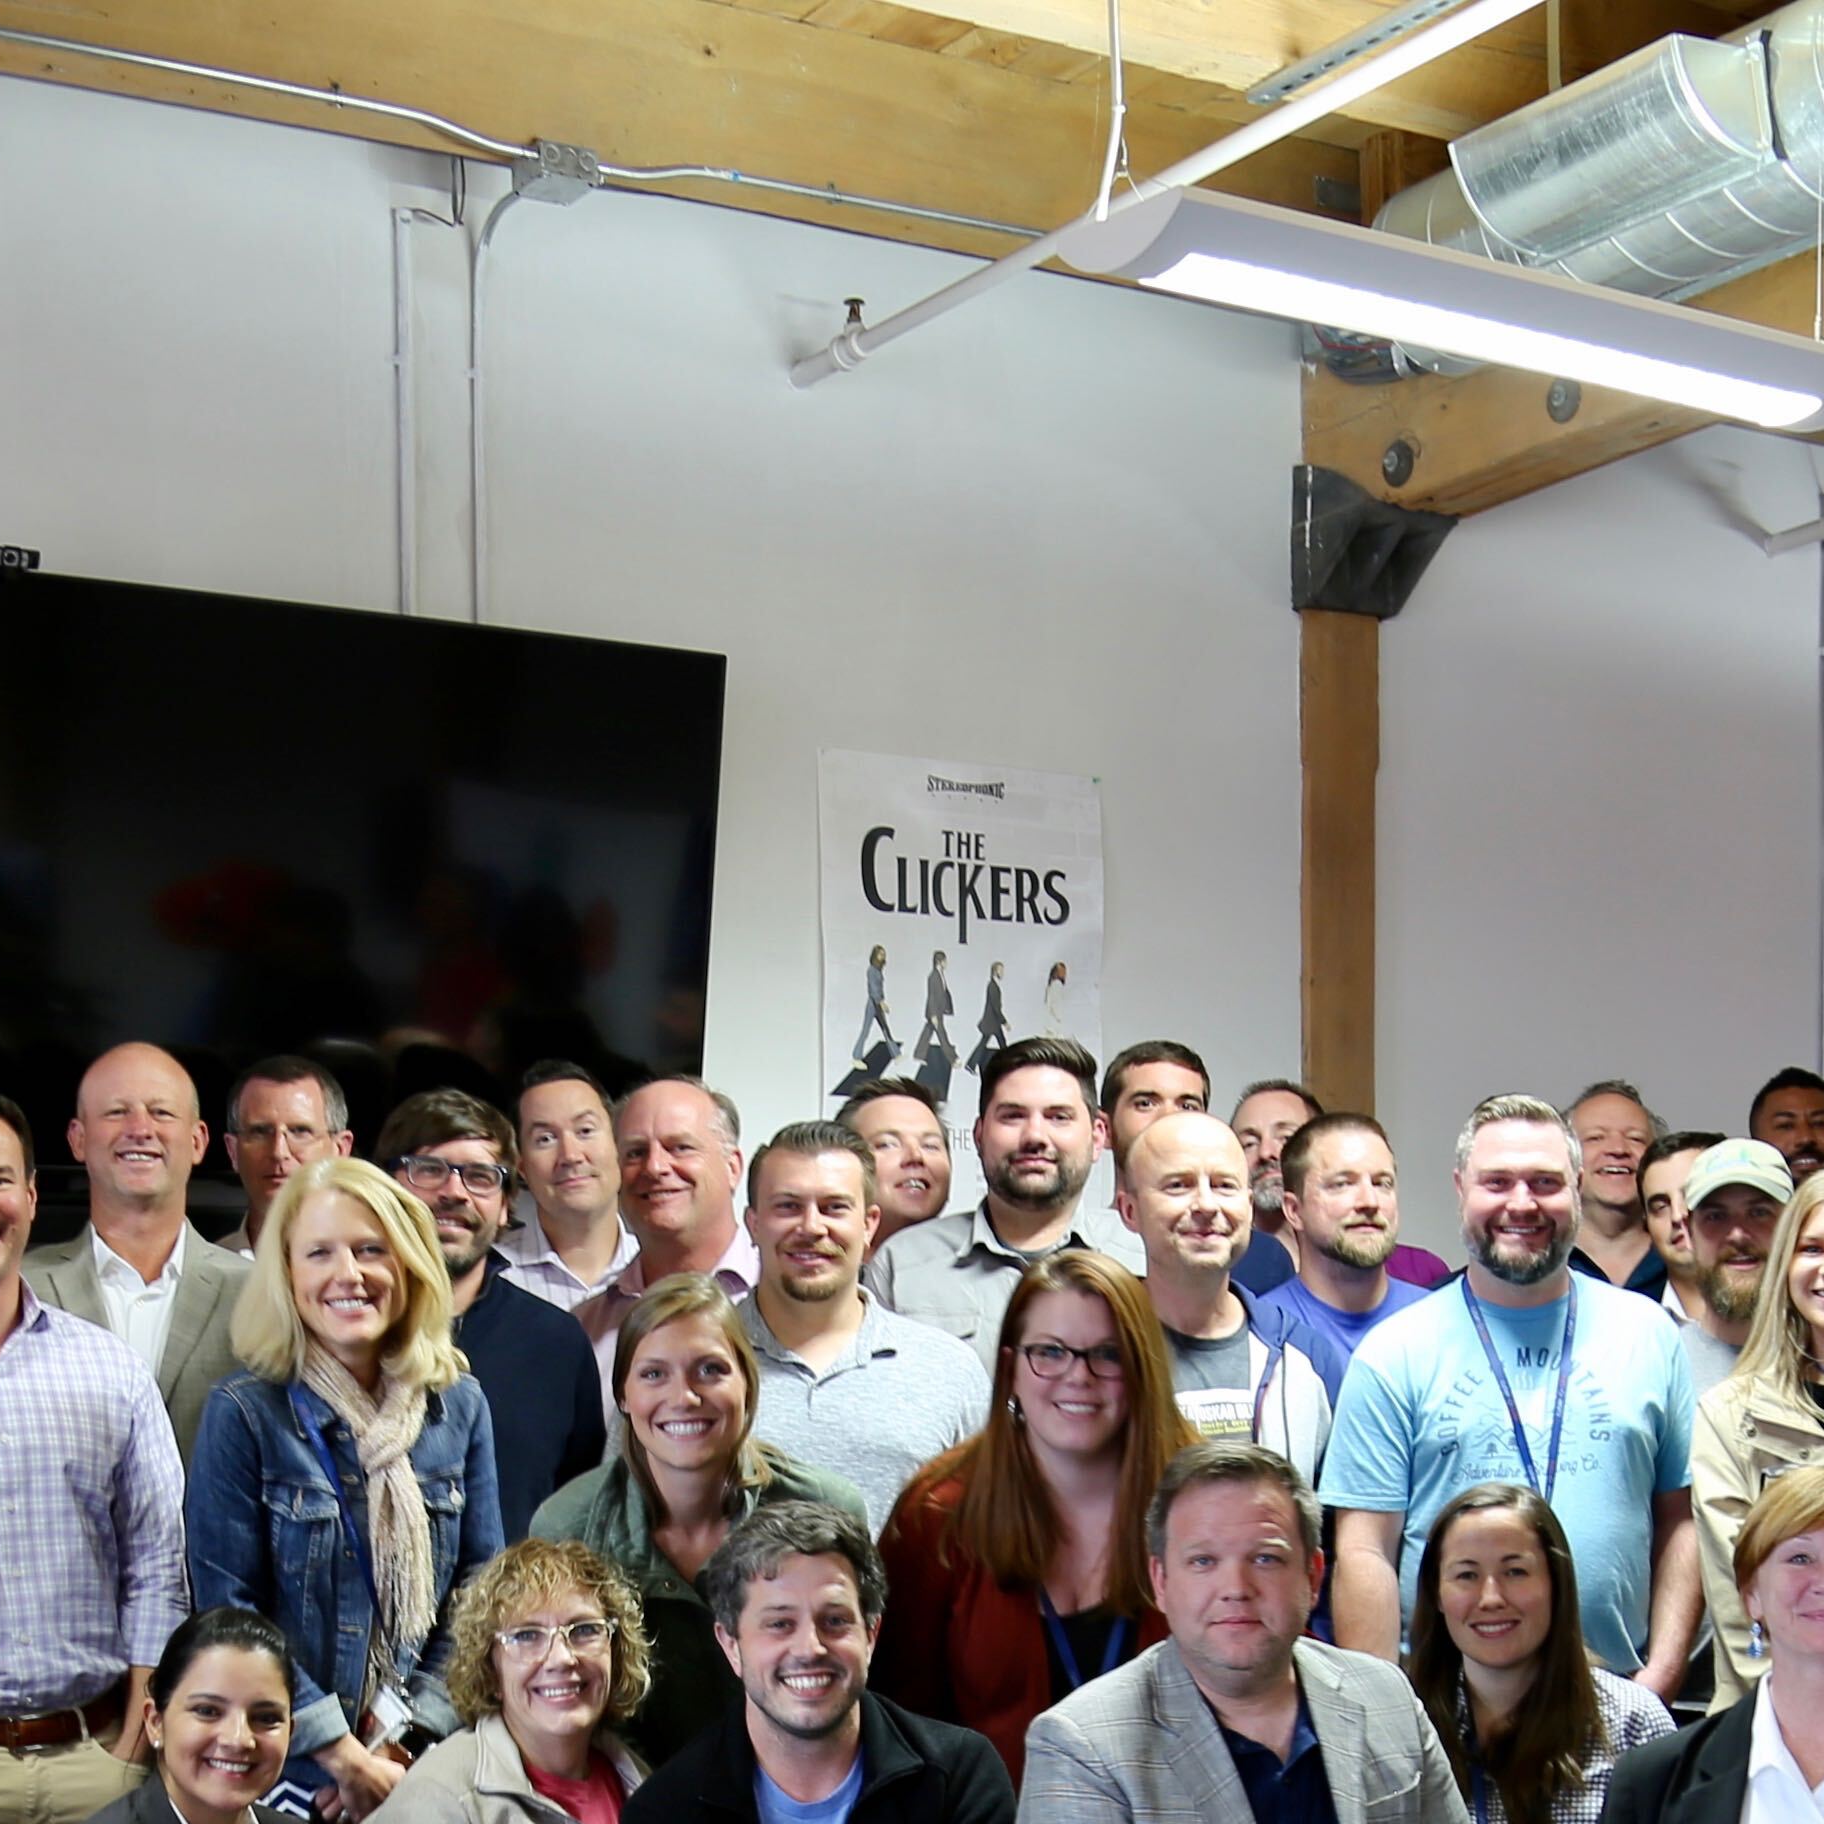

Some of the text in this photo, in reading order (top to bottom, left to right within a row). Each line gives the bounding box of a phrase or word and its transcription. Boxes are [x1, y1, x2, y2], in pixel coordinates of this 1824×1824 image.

[927, 774, 1005, 800] STEREOPHONIC
[860, 826, 1071, 944] CLICKERS
[941, 829, 986, 861] THE
[1437, 1368, 1485, 1457] COFFEE
[1516, 1346, 1613, 1443] MOUTAINS
